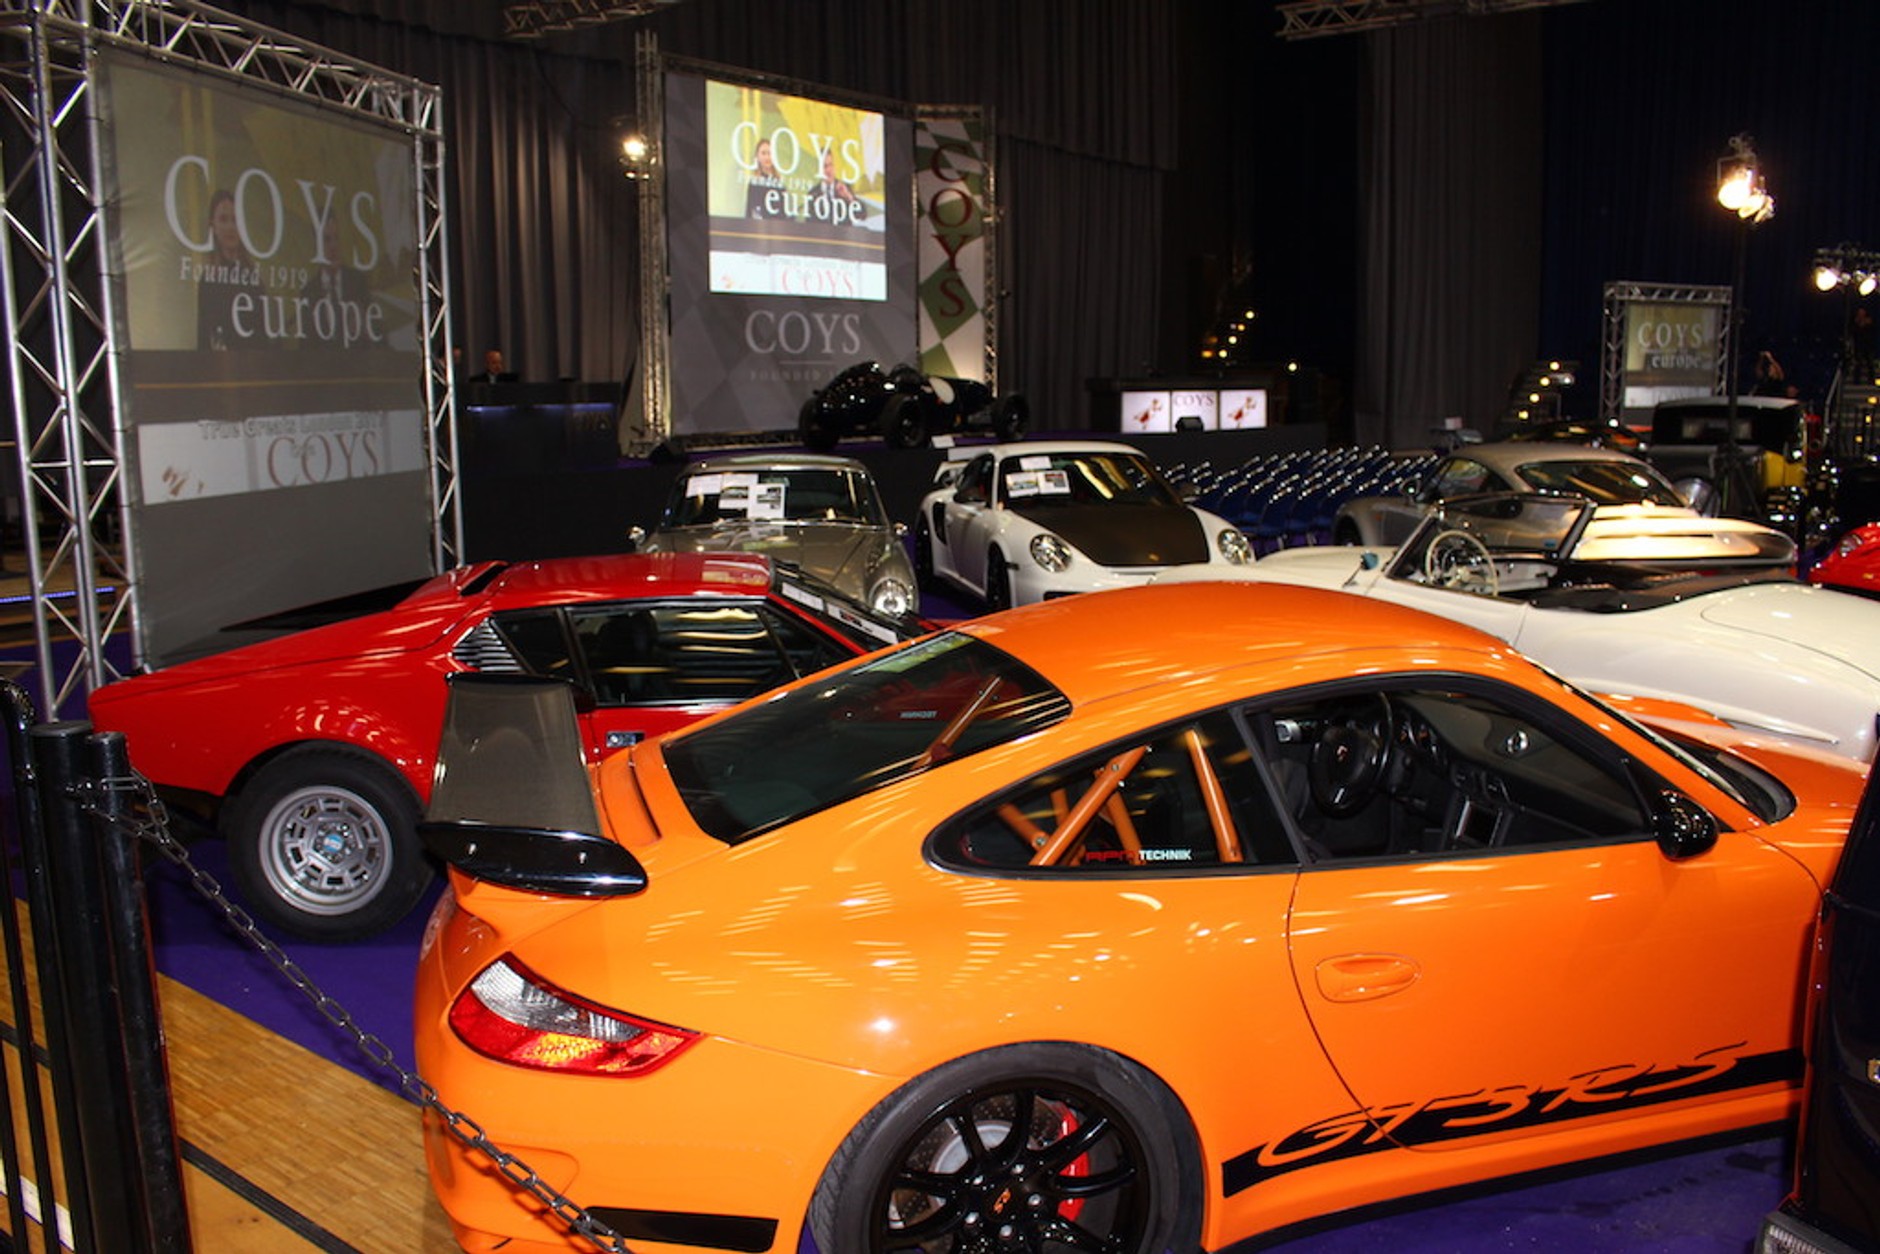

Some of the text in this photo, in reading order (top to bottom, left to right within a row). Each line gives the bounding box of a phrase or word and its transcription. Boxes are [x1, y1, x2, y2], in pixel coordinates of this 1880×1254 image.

[731, 121, 861, 185] COYS
[164, 155, 379, 271] COYS
[764, 189, 862, 227] europe
[930, 143, 972, 318] COYS
[180, 256, 309, 289] Founded 1919
[231, 292, 384, 349] europe
[744, 309, 861, 354] COYS
[1637, 321, 1703, 349] COYS
[1173, 394, 1214, 407] COYS
[266, 430, 379, 488] COYS
[1138, 849, 1193, 862] TECHNIK
